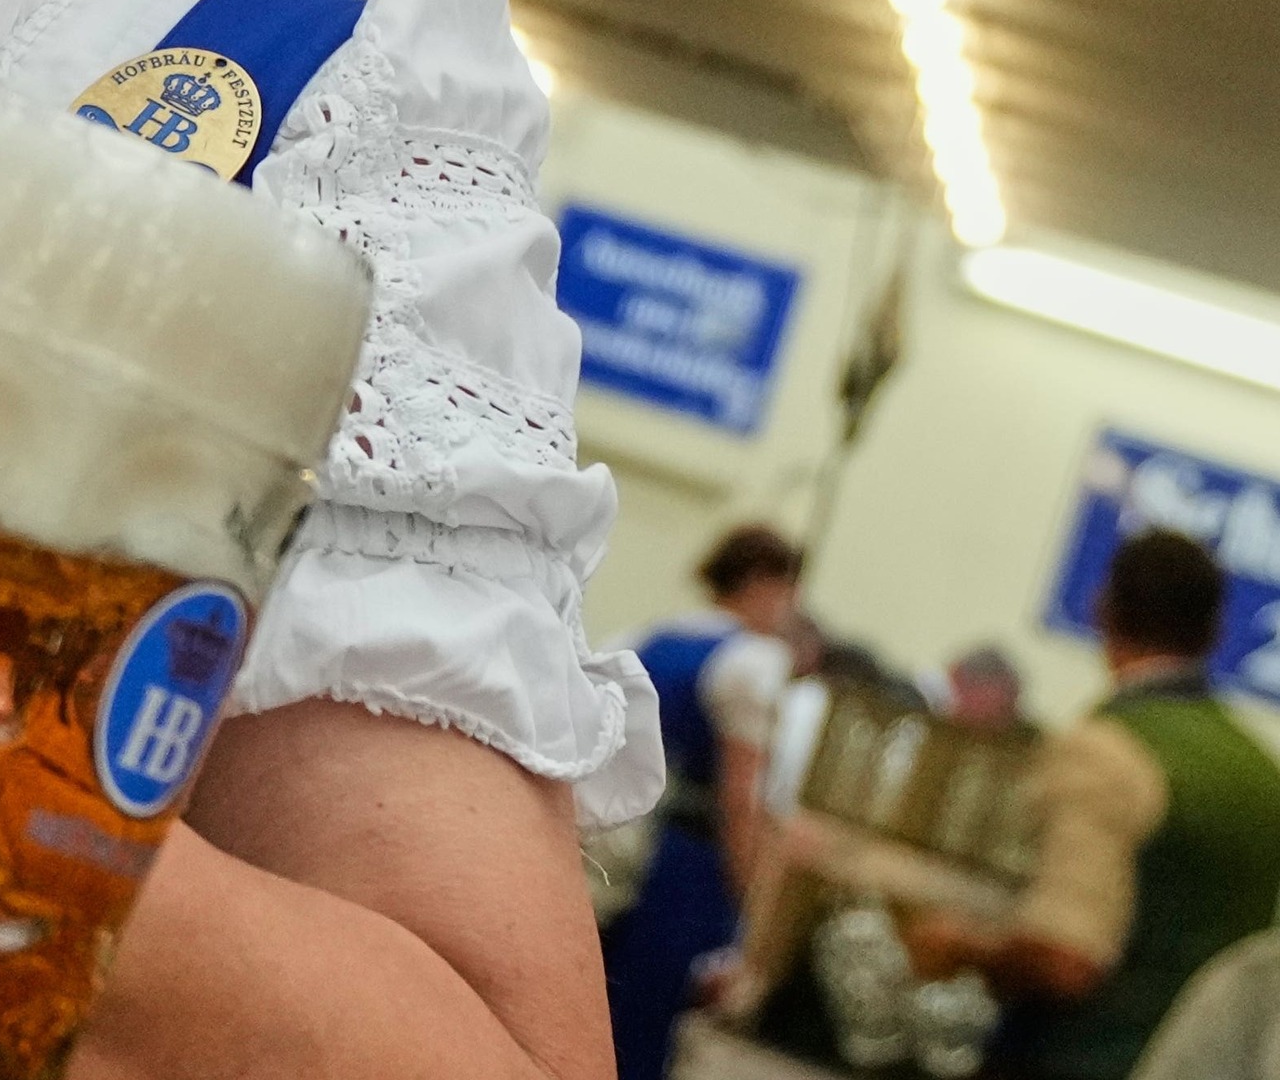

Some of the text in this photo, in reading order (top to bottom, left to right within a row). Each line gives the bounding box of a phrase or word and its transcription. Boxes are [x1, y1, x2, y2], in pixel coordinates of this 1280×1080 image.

[111, 50, 254, 149] HOFBRÄU FESTZELT
[123, 98, 198, 153] HB
[120, 684, 203, 783] HB
